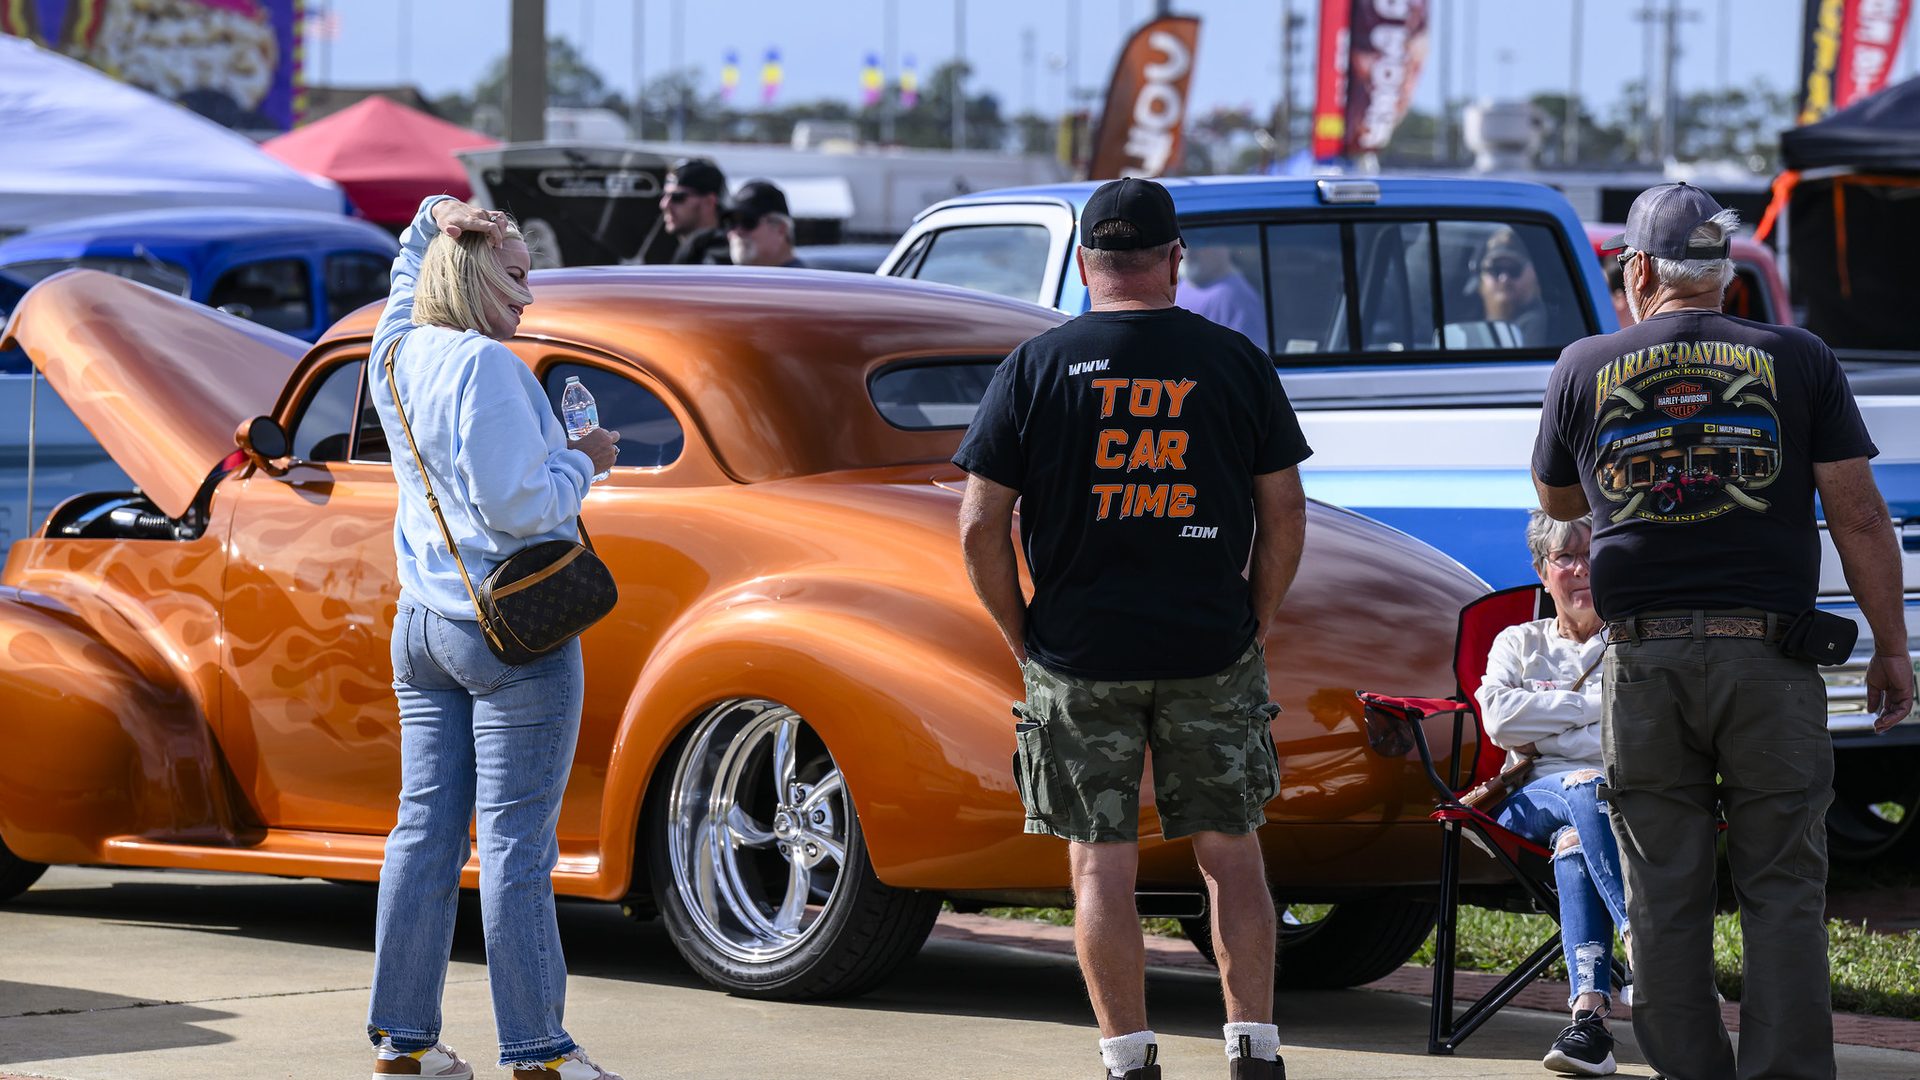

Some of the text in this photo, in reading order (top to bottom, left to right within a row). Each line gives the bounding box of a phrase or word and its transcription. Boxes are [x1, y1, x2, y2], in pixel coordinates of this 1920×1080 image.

[1594, 341, 1777, 420] HARLEY-DAVIDSON
[1684, 367, 1727, 381] ROUGE
[1669, 384, 1698, 394] MOTOR
[1091, 377, 1197, 419] TOY
[1657, 393, 1708, 406] HARLEY-DAVIDSON
[1669, 404, 1697, 416] CYCLES
[1095, 429, 1190, 473] CAR
[1091, 483, 1197, 521] TIME
[1640, 504, 1730, 523] LOUISIANA
[1178, 525, 1219, 538] .COM
